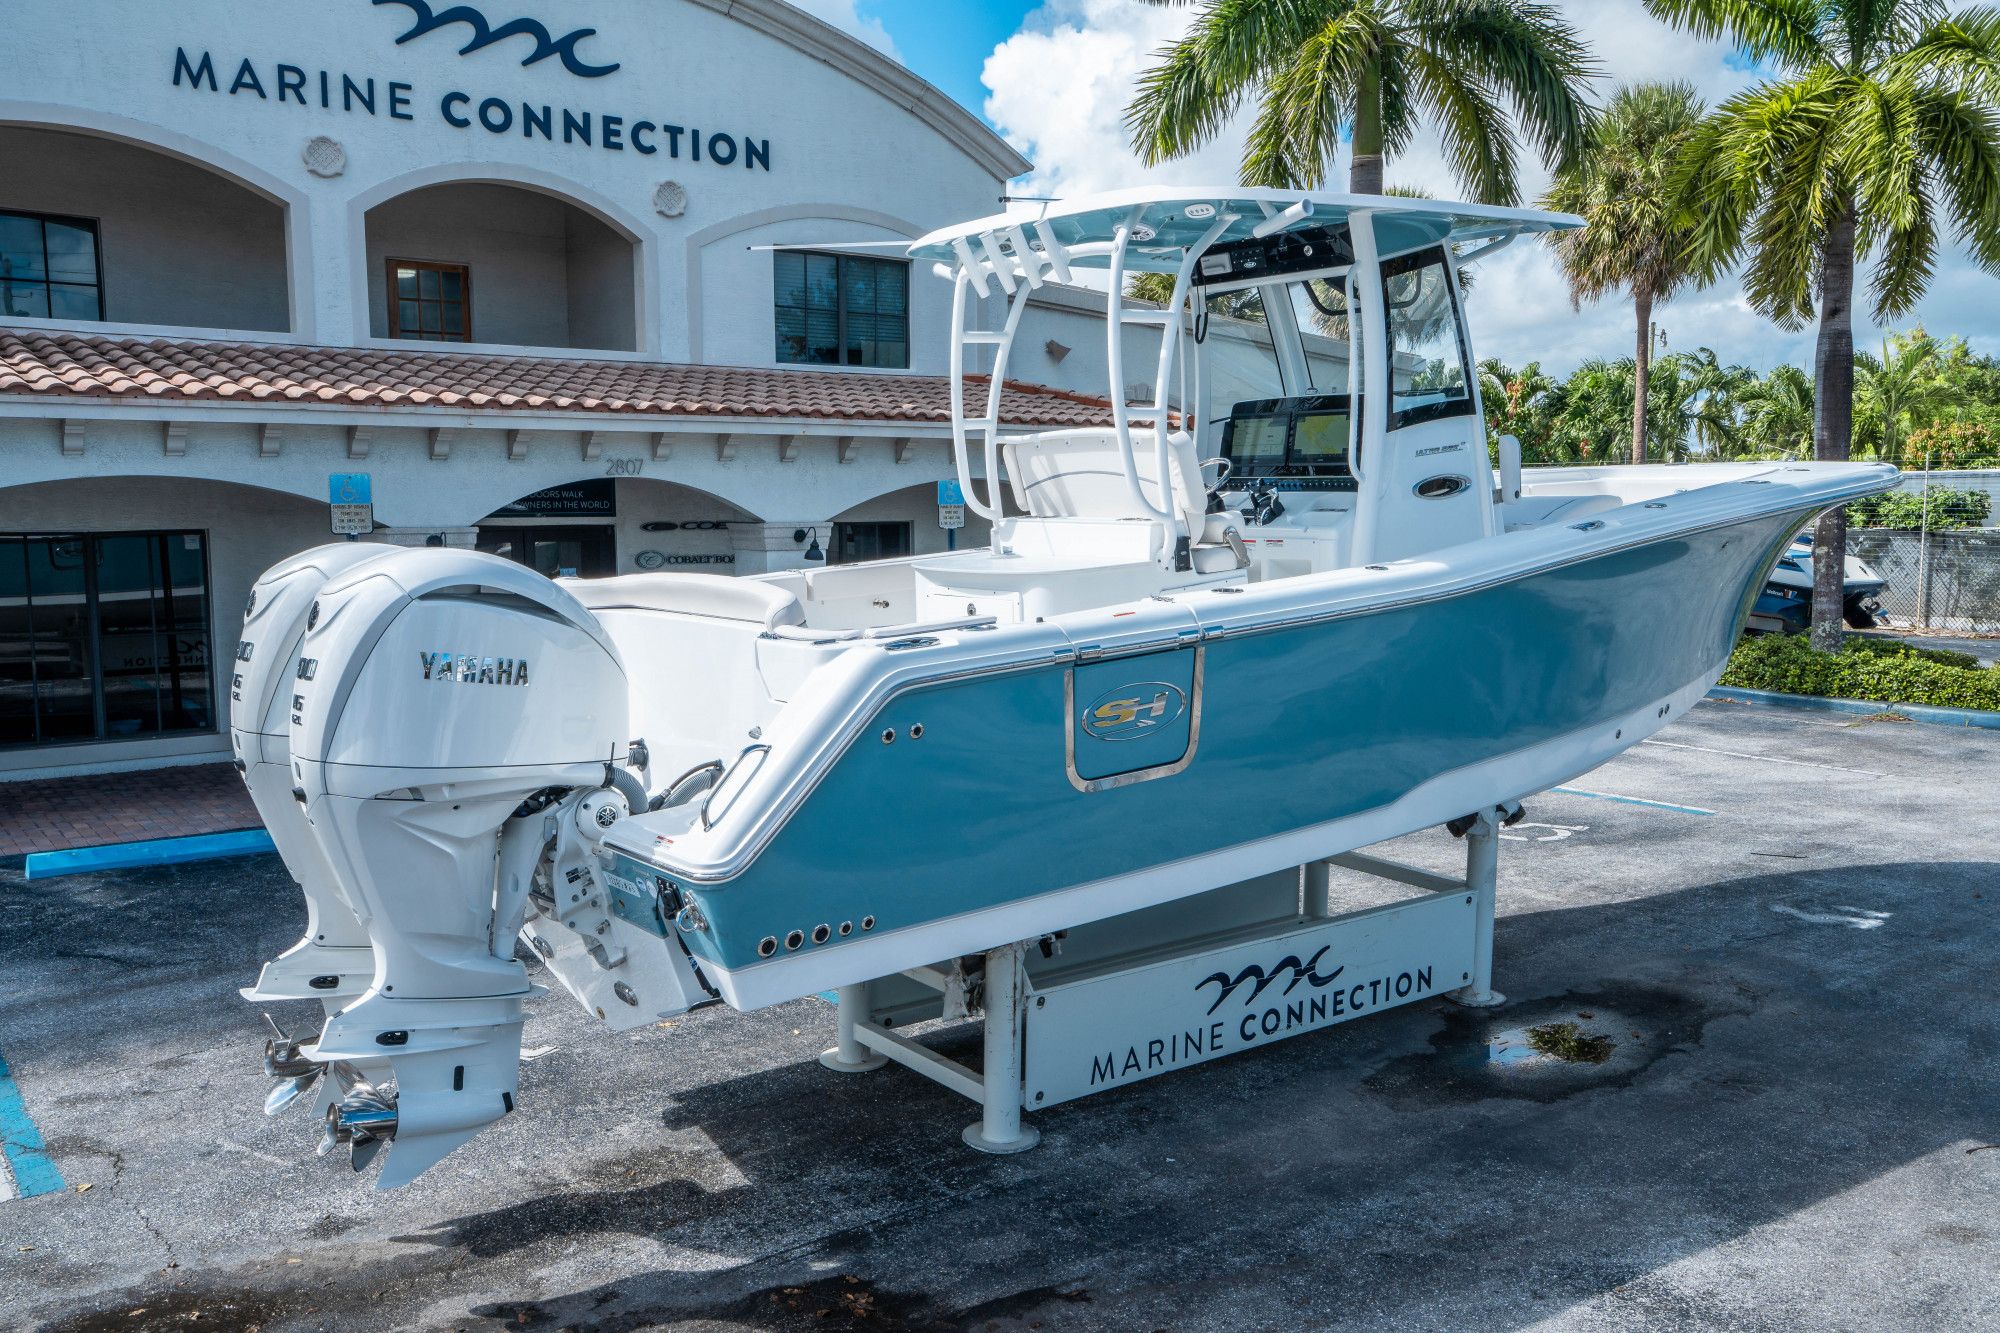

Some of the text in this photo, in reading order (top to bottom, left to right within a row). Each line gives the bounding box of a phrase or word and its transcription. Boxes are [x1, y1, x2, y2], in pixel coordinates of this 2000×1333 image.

[173, 47, 770, 171] MARINE CONNECTION
[606, 458, 643, 475] 2807
[561, 490, 583, 498] WALK
[553, 501, 561, 509] IN
[564, 501, 578, 509] THE
[580, 501, 610, 509] WORLD
[667, 554, 713, 564] COBALT
[420, 652, 529, 686] YAMAHA
[1090, 966, 1432, 1085] MARINE CONNECTION
